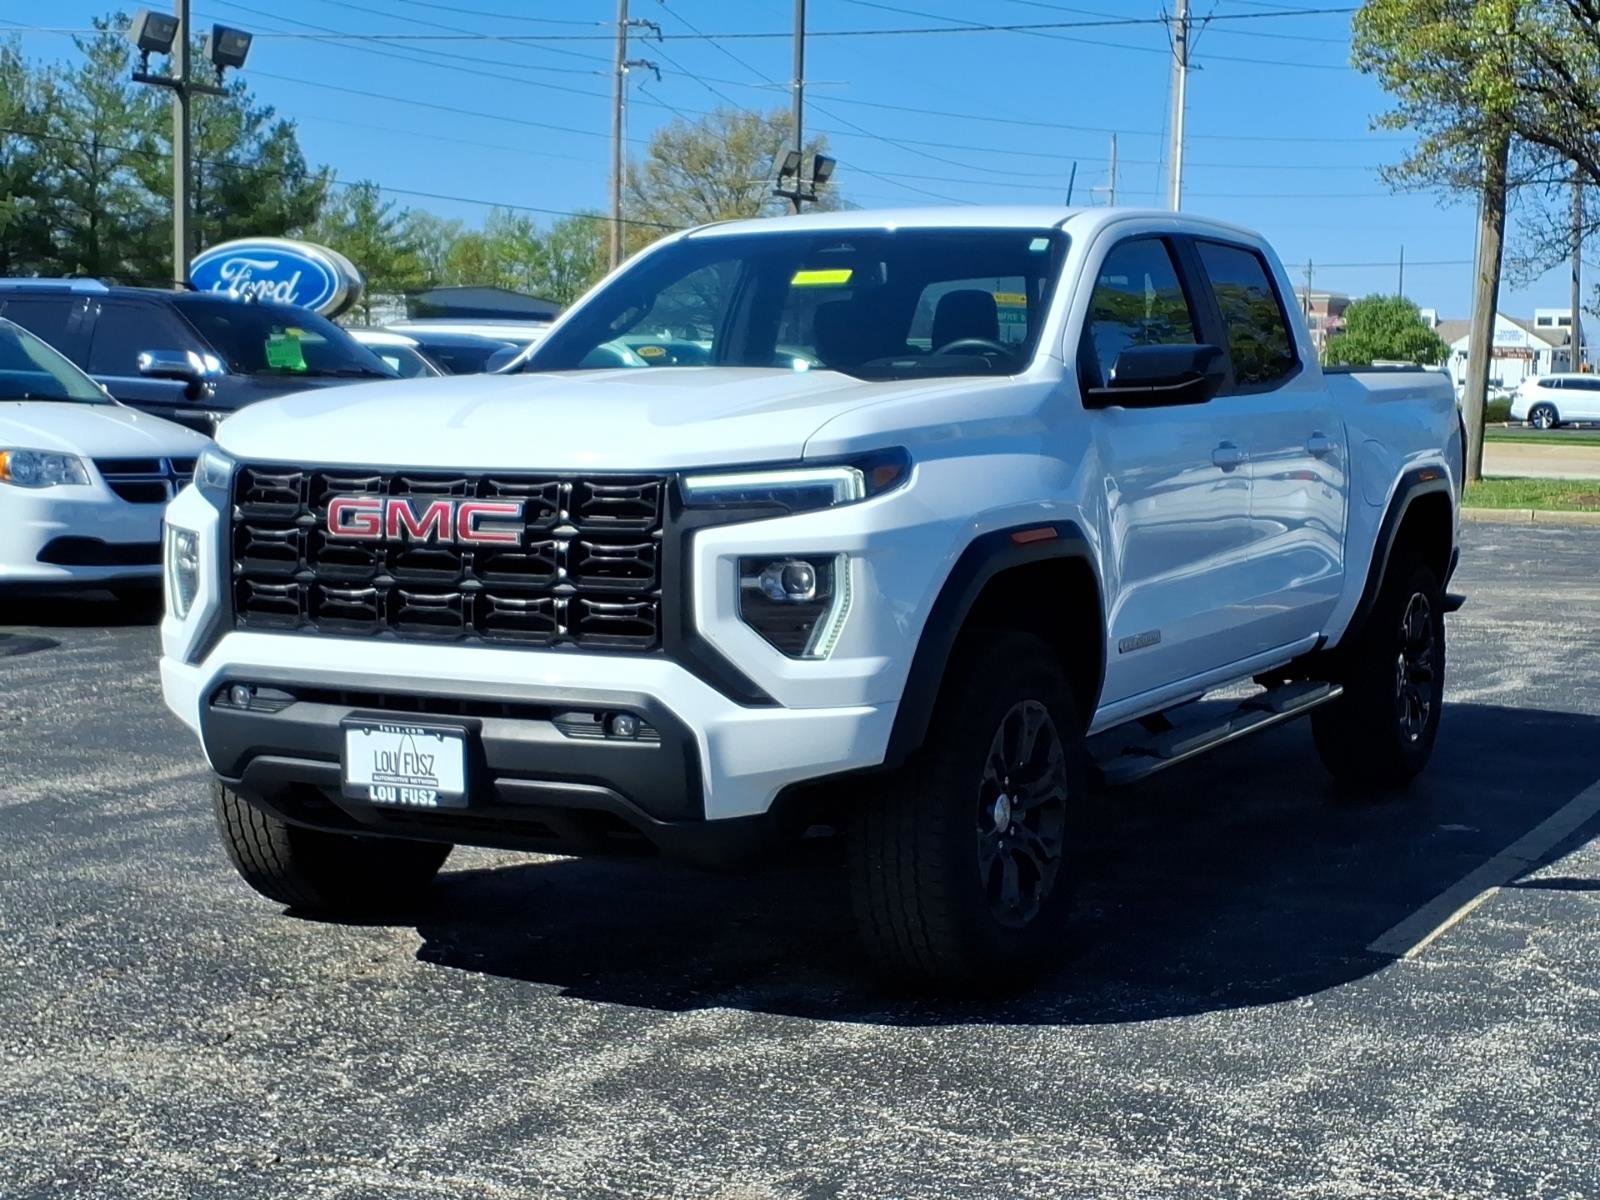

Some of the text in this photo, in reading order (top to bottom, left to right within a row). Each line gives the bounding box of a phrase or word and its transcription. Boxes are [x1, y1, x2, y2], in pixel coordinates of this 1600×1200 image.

[213, 257, 302, 303] Ford
[327, 497, 524, 546] GMC
[374, 749, 436, 777] LOU FUSZ
[369, 785, 438, 806] LOU FUSZ
